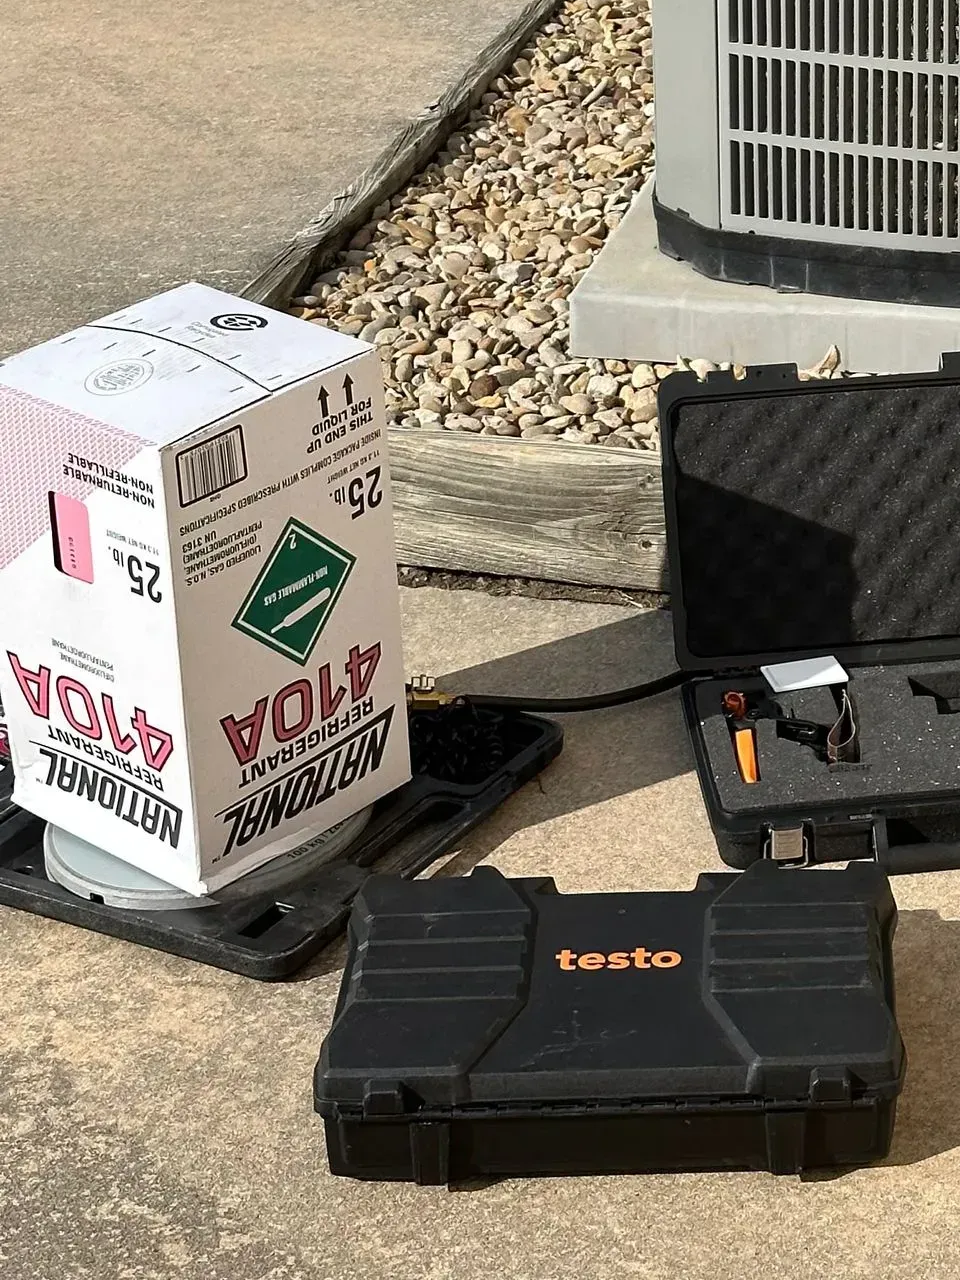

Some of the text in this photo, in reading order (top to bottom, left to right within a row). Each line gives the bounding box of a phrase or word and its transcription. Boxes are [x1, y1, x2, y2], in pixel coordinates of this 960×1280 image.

[307, 411, 373, 454] THIS END UP
[312, 397, 371, 436] FOR LIQUID
[62, 464, 155, 509] NON-RETURNABLE
[67, 452, 154, 494] NON-REFILLABLE
[179, 429, 381, 536] INSIDE PACKAGE COMPLIES WITH PRESCRIBED SPECIFICATIONS
[327, 466, 349, 484] WEIGHT
[349, 460, 359, 473] NET
[329, 465, 383, 521] 25 lb.
[108, 546, 124, 568] lb.
[182, 530, 217, 553] UN 3163
[226, 544, 262, 568] LIQUEFIED
[288, 533, 297, 550] 2
[127, 554, 163, 603] 25
[263, 565, 329, 606] NON-FLAMMABLE GAS
[6, 650, 174, 773] 410A
[218, 641, 382, 766] 410A
[48, 724, 164, 792] REFRIGERANT
[238, 696, 374, 789] REFRIGERANT
[39, 748, 183, 849] NATIONAL
[216, 704, 395, 857] NATIONAL
[287, 846, 309, 859] 100
[310, 837, 325, 848] kg
[555, 947, 682, 971] testo
